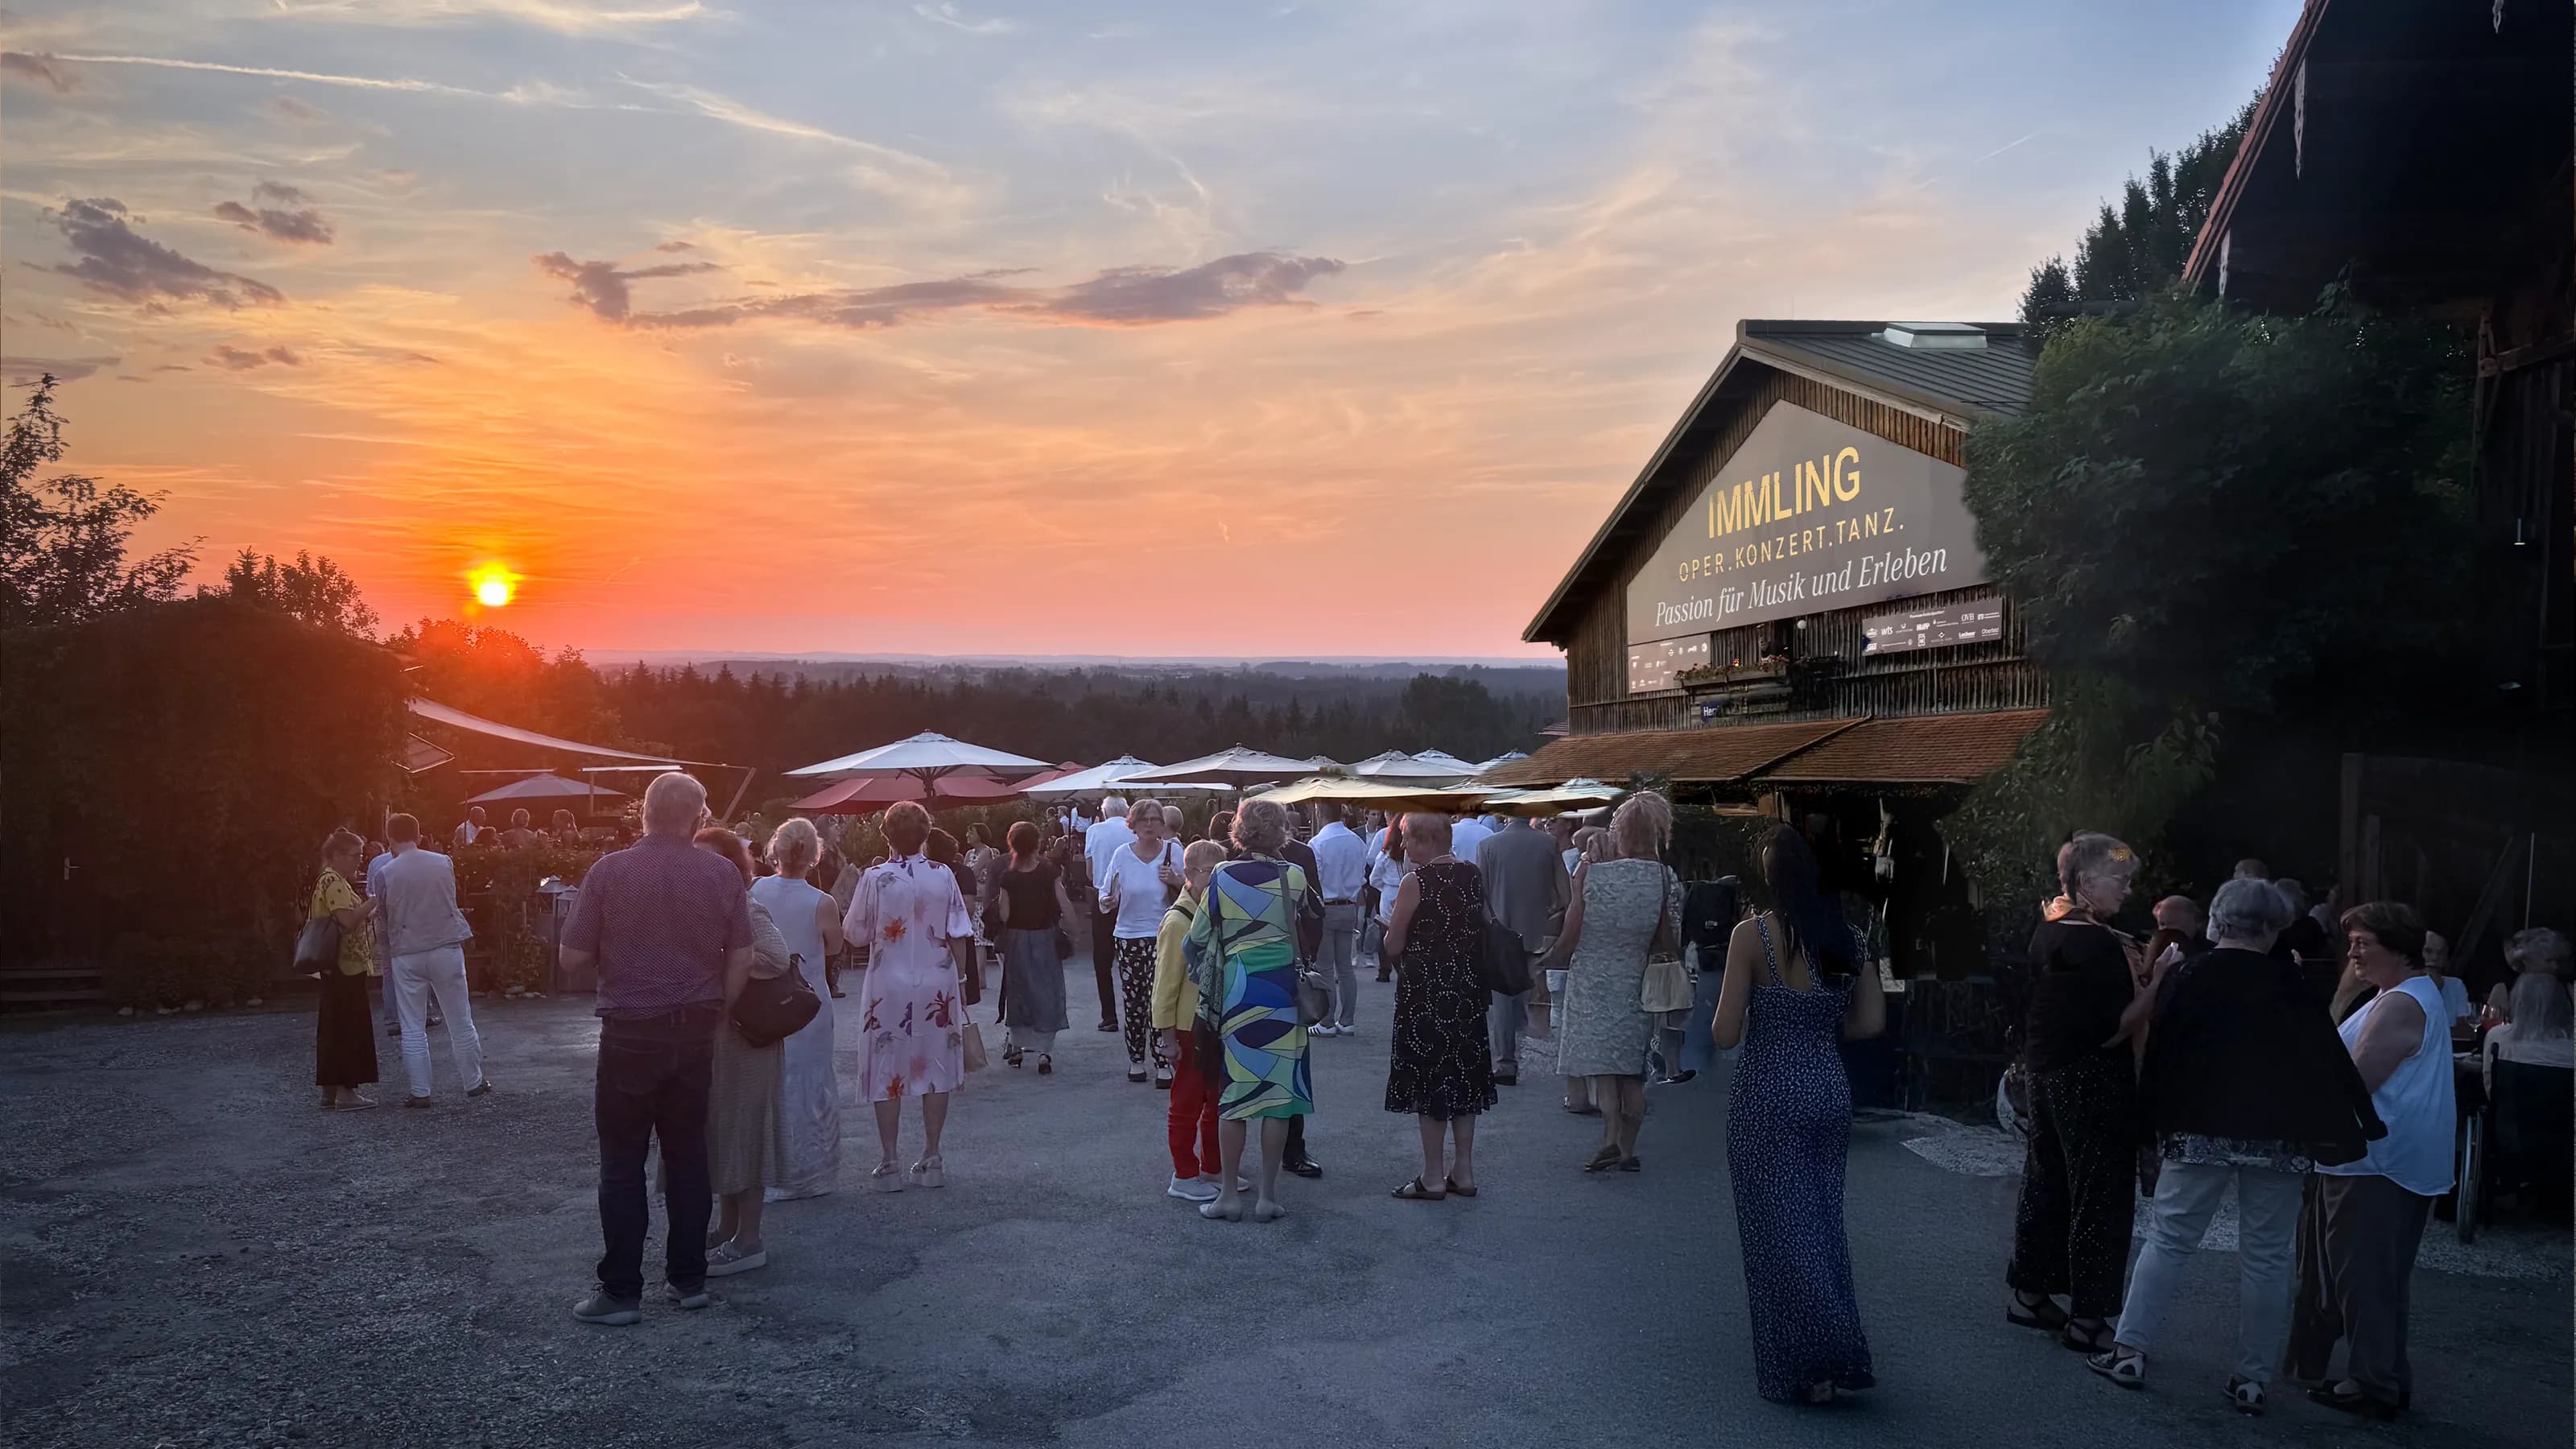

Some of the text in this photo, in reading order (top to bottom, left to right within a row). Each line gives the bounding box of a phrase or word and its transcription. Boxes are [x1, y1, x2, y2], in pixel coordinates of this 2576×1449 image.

[1708, 447, 1860, 539] IMMLING
[1655, 547, 1947, 627] Passion für Musik und Erleben
